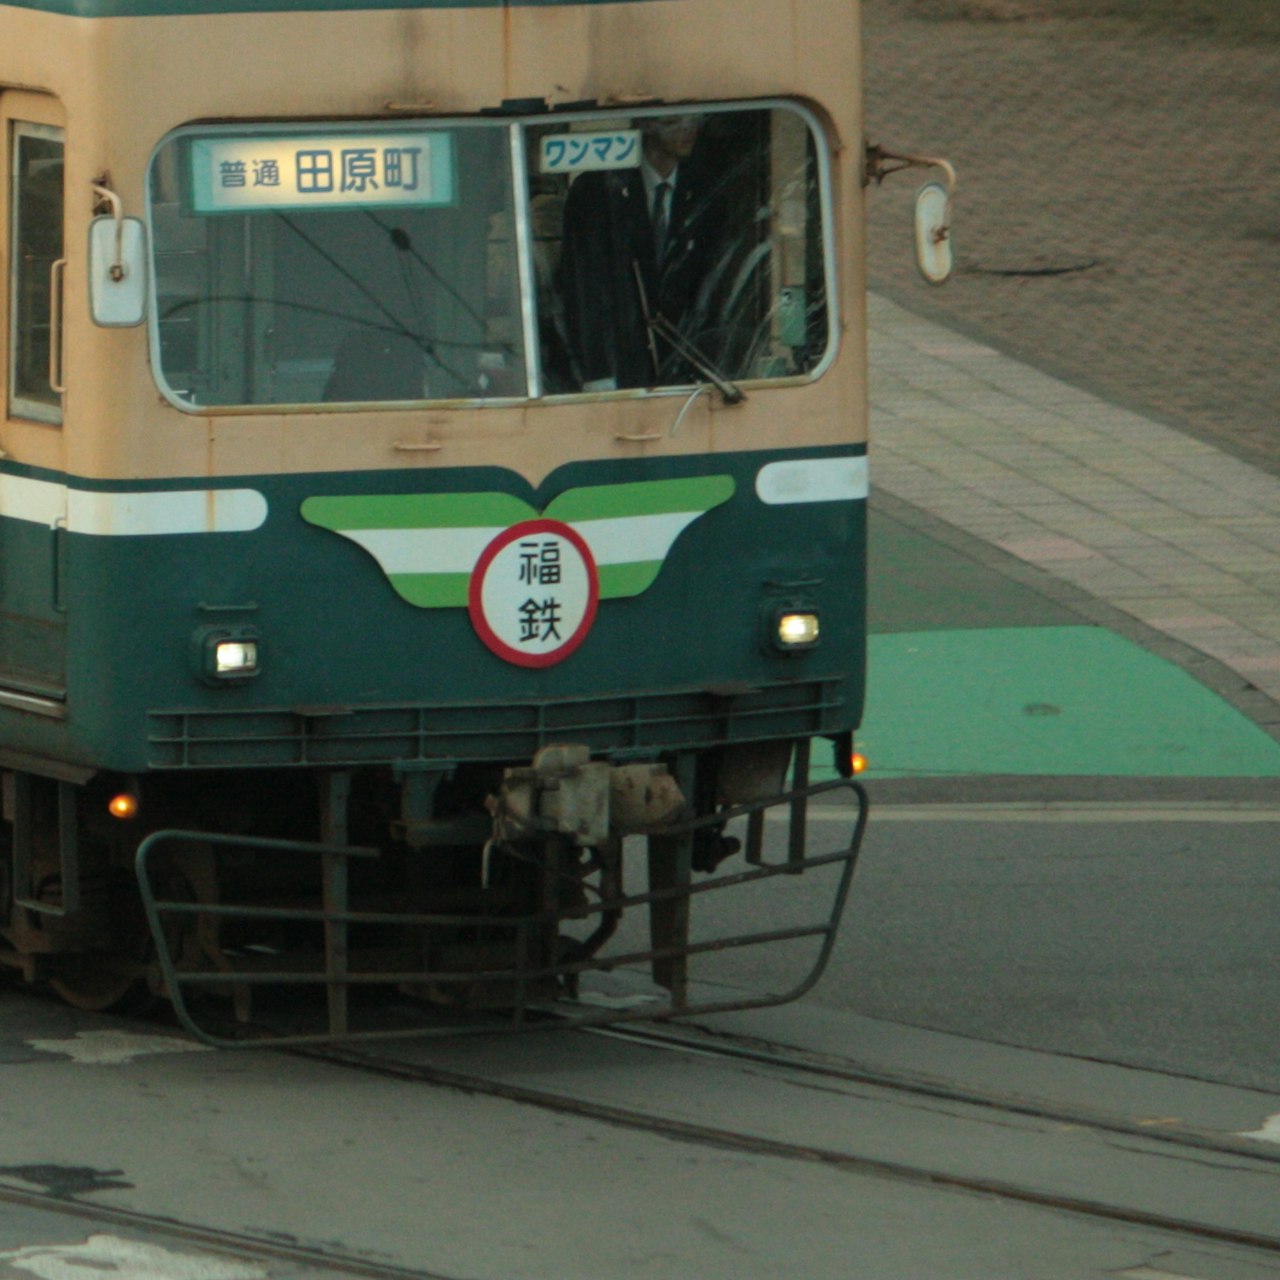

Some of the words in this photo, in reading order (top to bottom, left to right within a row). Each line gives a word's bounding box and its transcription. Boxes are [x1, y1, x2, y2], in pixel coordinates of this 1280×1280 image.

[219, 159, 282, 189] 普通
[294, 146, 422, 194] 田原町
[544, 135, 637, 167] ワンマン
[518, 542, 562, 642] 福鉄
